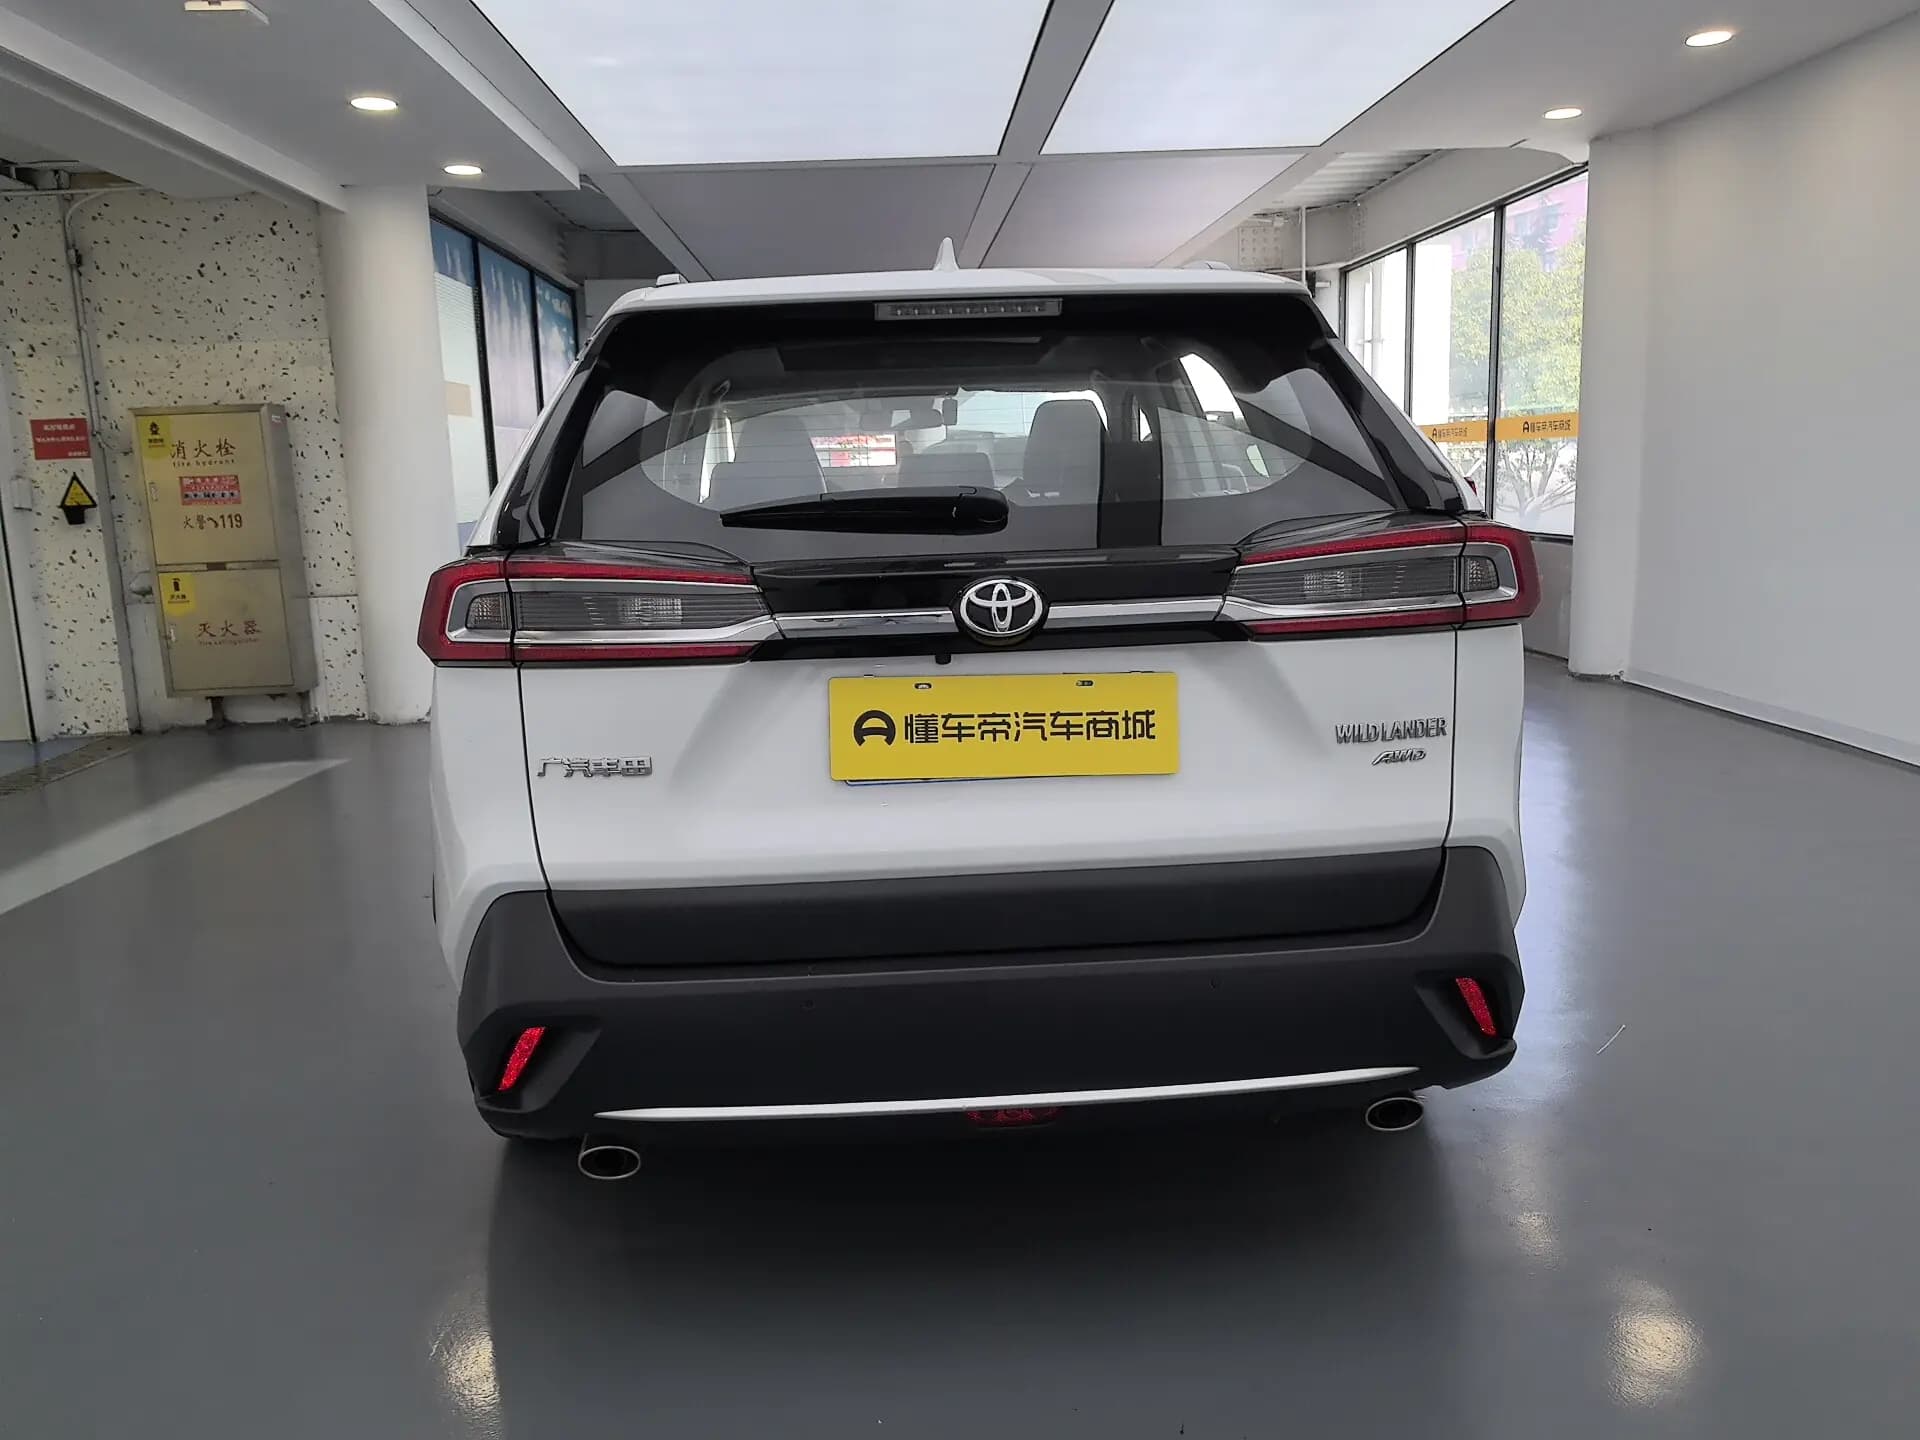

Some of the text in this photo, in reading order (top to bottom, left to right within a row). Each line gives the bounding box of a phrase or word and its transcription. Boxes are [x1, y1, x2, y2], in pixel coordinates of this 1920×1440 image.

[170, 437, 236, 460] 消火栓
[219, 513, 243, 529] 119
[904, 709, 1156, 744] 懂车帝汽车商城
[537, 756, 652, 777] 广汽丰田
